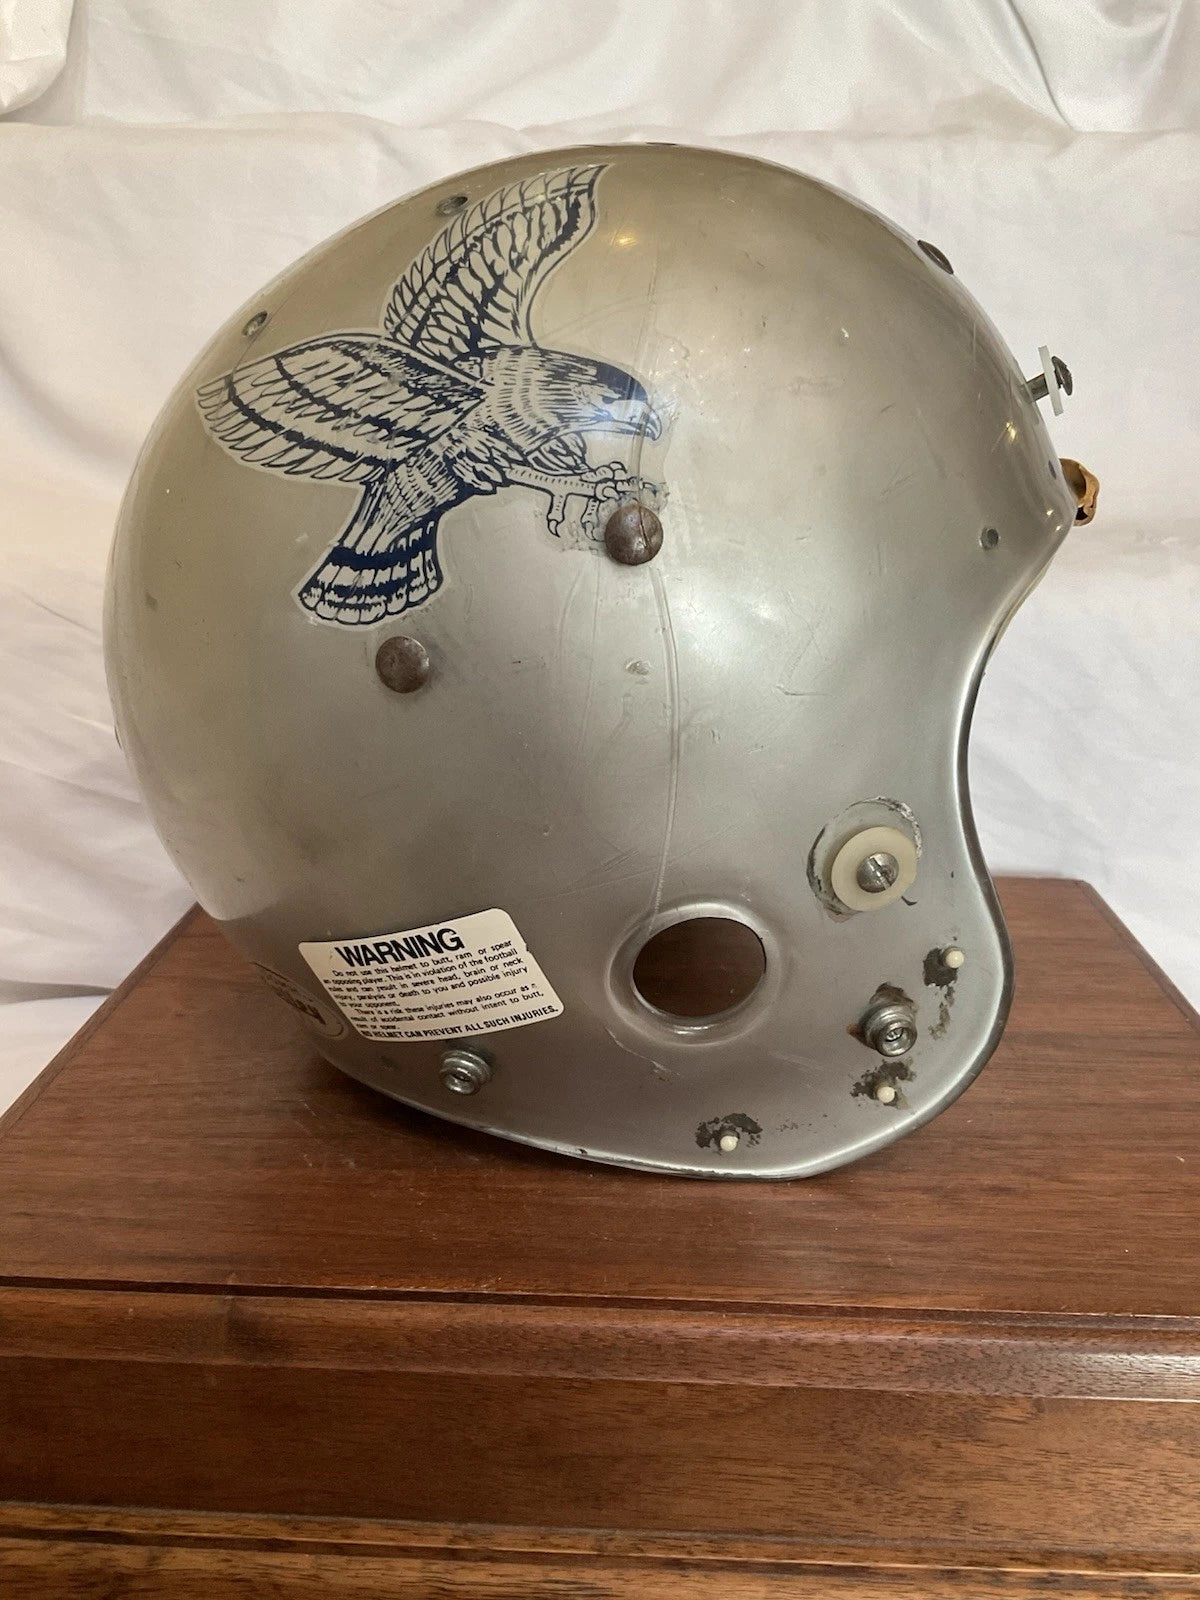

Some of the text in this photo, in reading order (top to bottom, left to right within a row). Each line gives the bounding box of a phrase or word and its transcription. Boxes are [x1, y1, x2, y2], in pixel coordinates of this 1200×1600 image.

[335, 928, 465, 967] WARNING
[391, 963, 417, 972] helmet
[432, 957, 454, 967] butt,
[456, 952, 472, 960] ram
[491, 941, 512, 951] spear
[422, 964, 457, 976] violation
[468, 958, 484, 966] the
[484, 948, 518, 962] football
[376, 984, 398, 992] result
[412, 979, 435, 987] severe
[464, 966, 486, 978] brain
[490, 964, 499, 972] or
[503, 958, 523, 968] neck
[399, 990, 420, 998] death
[432, 986, 448, 994] you
[450, 981, 466, 990] and
[468, 974, 500, 987] possible
[503, 966, 528, 978] injury
[418, 1012, 444, 1020] contact
[448, 1006, 479, 1016] without
[482, 1000, 507, 1010] intent
[522, 991, 544, 1000] butt,
[426, 1002, 454, 1012] injuries
[456, 999, 473, 1007] may
[476, 994, 492, 1003] also
[494, 988, 517, 998] occur
[423, 1025, 462, 1036] PREVENT
[465, 1022, 484, 1031] ALL
[484, 1016, 510, 1028] SUCH
[512, 1005, 558, 1023] INJURIES.
